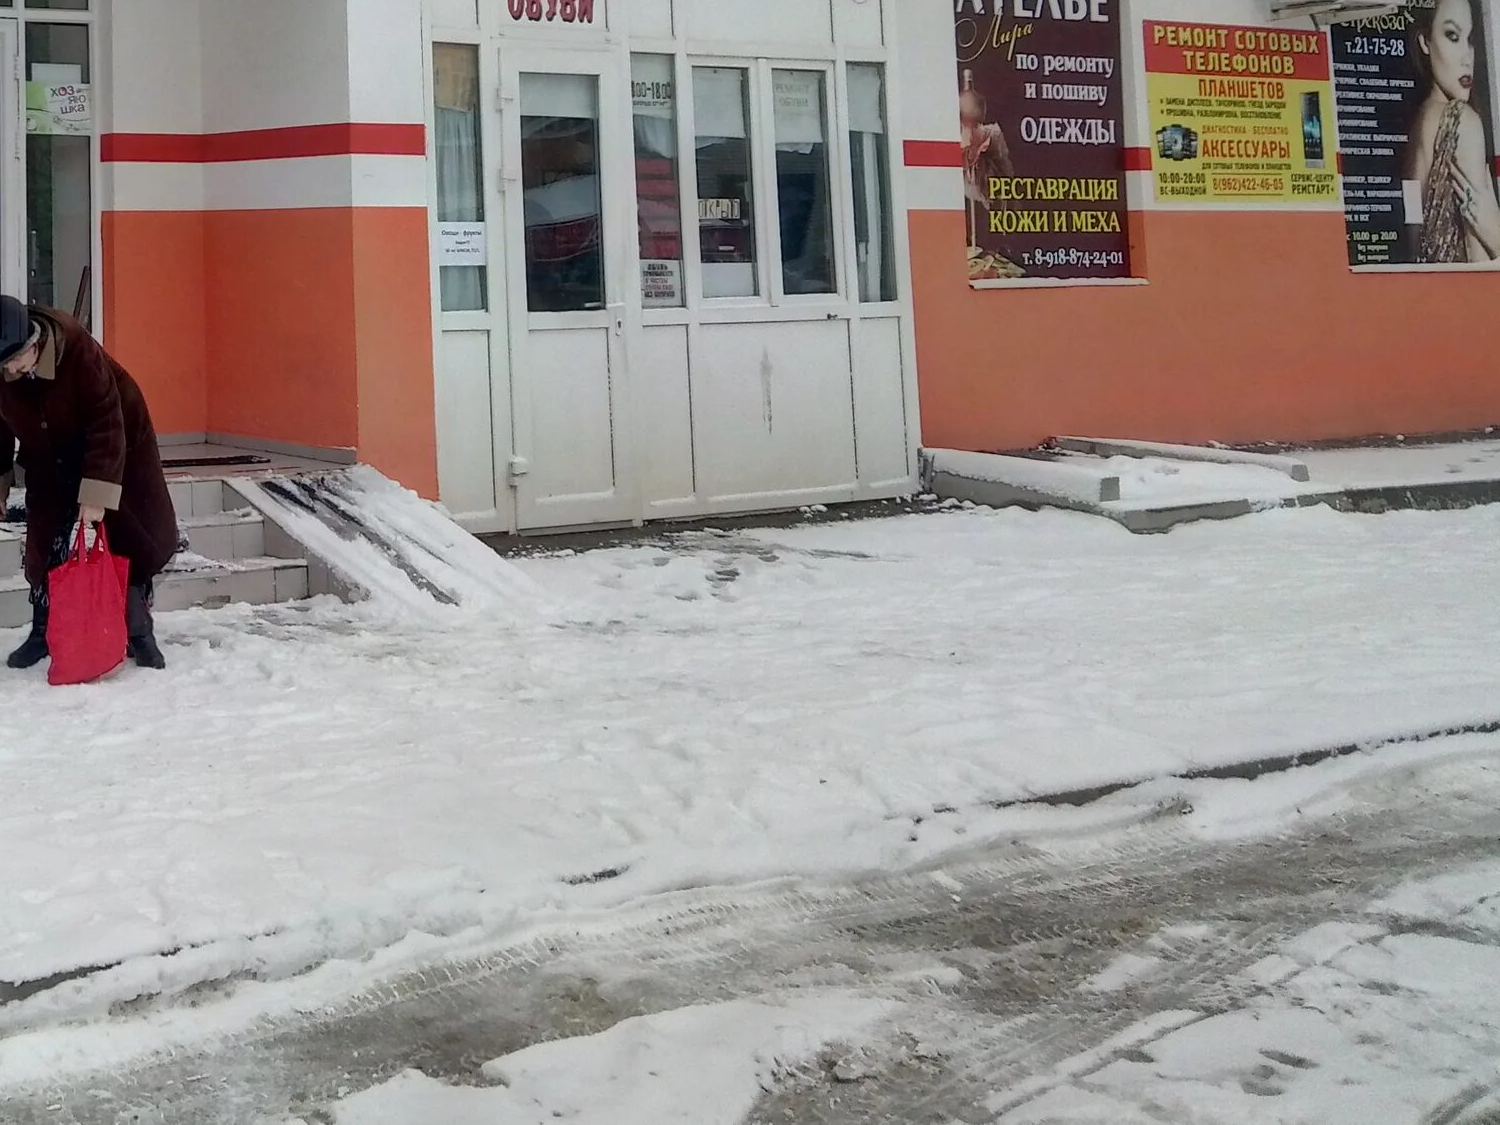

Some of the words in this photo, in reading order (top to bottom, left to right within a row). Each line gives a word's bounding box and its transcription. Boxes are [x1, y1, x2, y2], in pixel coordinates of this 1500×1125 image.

[1153, 25, 1229, 49] РЕМОНТ
[1234, 30, 1320, 54] СОТОВЫХ
[1015, 53, 1039, 71] по
[1043, 55, 1115, 79] ремонту
[1182, 50, 1295, 75] ТЕЛЕФОНОВ
[1024, 82, 1037, 99] и
[1041, 83, 1108, 107] пошиву
[1198, 78, 1285, 100] ПЛАНШЕТОВ
[1020, 116, 1116, 146] ОДЕЖДЫ
[1201, 139, 1291, 159] АКСЕССУАРЫ
[988, 177, 1119, 203] РЕСТАВРАЦИЯ
[1158, 173, 1206, 185] 10:00-20:00
[989, 209, 1050, 233] КОЖИ
[1052, 210, 1068, 233] И
[1071, 210, 1122, 233] МЕХА
[1022, 252, 1034, 266] т.
[1034, 248, 1124, 268] 8-918-874-24-01
